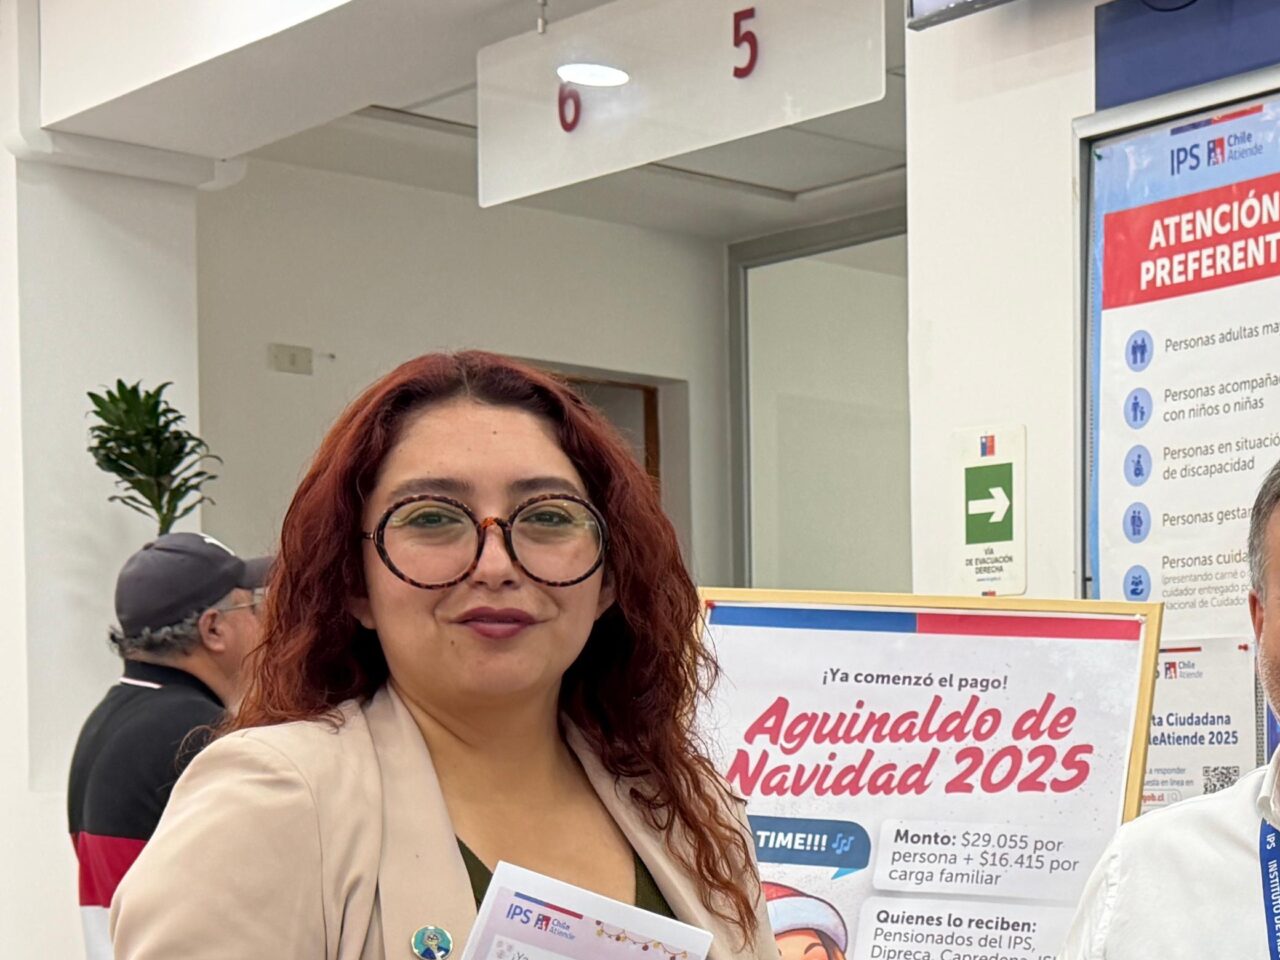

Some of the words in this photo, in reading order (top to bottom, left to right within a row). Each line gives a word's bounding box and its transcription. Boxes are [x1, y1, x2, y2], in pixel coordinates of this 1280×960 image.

[733, 7, 758, 79] 5
[1227, 129, 1252, 148] Chile
[1170, 142, 1200, 177] IPS
[1148, 188, 1280, 250] ATENCIÓN
[1164, 333, 1216, 352] Personas
[1217, 325, 1259, 344] adultas
[1163, 384, 1215, 402] Personas
[1162, 408, 1185, 422] con
[1187, 402, 1220, 418] niños
[1221, 402, 1231, 414] o
[1232, 395, 1264, 412] niñas
[1162, 443, 1215, 460] Personas
[1216, 441, 1232, 454] en
[1162, 465, 1177, 480] de
[1179, 455, 1255, 478] discapacidad
[1162, 511, 1214, 527] Personas
[1162, 555, 1214, 569] Personas
[1216, 549, 1248, 564] cuida
[822, 667, 849, 685] ¡Ya
[853, 672, 934, 687] comenzó
[937, 672, 953, 687] el
[957, 674, 1008, 692] pago!
[743, 694, 1003, 756] Aguinaldo
[1011, 692, 1077, 742] de
[1167, 713, 1232, 727] Ciudadana
[1148, 731, 1205, 746] leAtiende
[1209, 731, 1238, 745] 2025
[725, 747, 941, 798] Navidad
[945, 744, 1094, 795] 2025
[755, 829, 827, 851] TIME!!!
[894, 829, 957, 848] Monto:
[961, 831, 1028, 851] $29.055
[1032, 839, 1063, 856] por
[1266, 833, 1276, 850] IPS
[890, 850, 957, 865] persona
[962, 853, 973, 865] +
[978, 850, 1044, 870] $16.415
[1048, 858, 1079, 874] por
[887, 868, 934, 885] carga
[938, 868, 1001, 885] familiar
[505, 903, 533, 925] IPS
[875, 909, 943, 926] Quienes
[946, 912, 963, 928] lo
[967, 916, 1036, 933] reciben:
[872, 926, 973, 947] Pensionados
[977, 934, 1002, 949] del
[1007, 935, 1036, 952] IPS,
